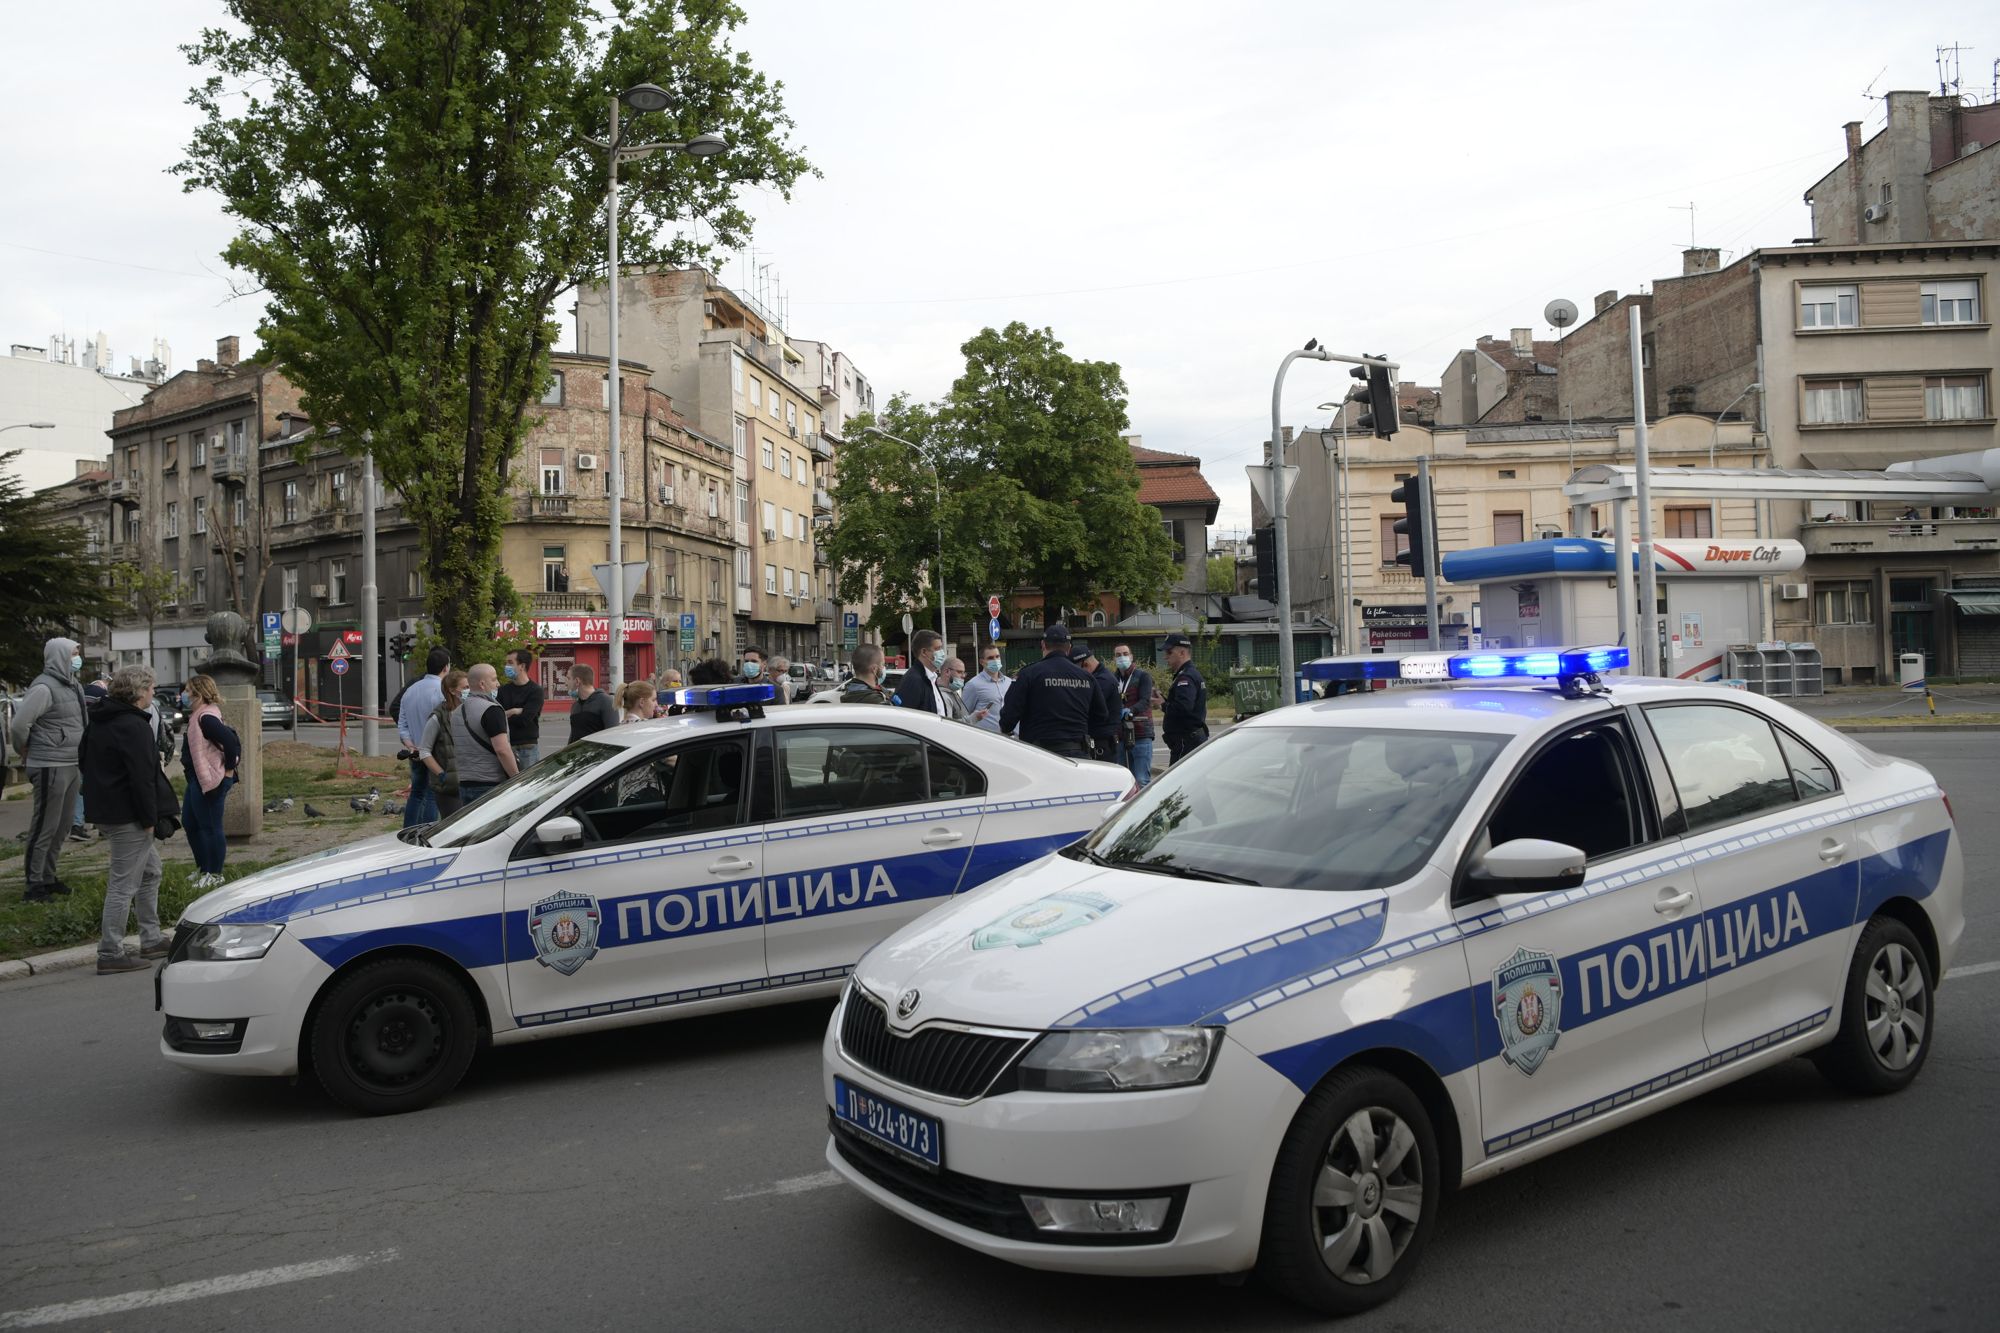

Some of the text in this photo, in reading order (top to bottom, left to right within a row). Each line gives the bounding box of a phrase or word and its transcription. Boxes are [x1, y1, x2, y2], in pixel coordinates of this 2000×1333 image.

[1704, 545, 1781, 563] DRIVE Cafe
[584, 617, 610, 631] АУТ
[1400, 662, 1449, 675] ПОЛИЦИЈА
[1044, 678, 1091, 689] ПОЛИЦИЈА
[540, 899, 586, 912] ПОЛИЦИЈА
[617, 865, 898, 940] ПОЛИЦИЈА
[1578, 891, 1809, 1016] ПОЛИЦИЈА
[1503, 959, 1547, 982] ПОЛИЦИЈА
